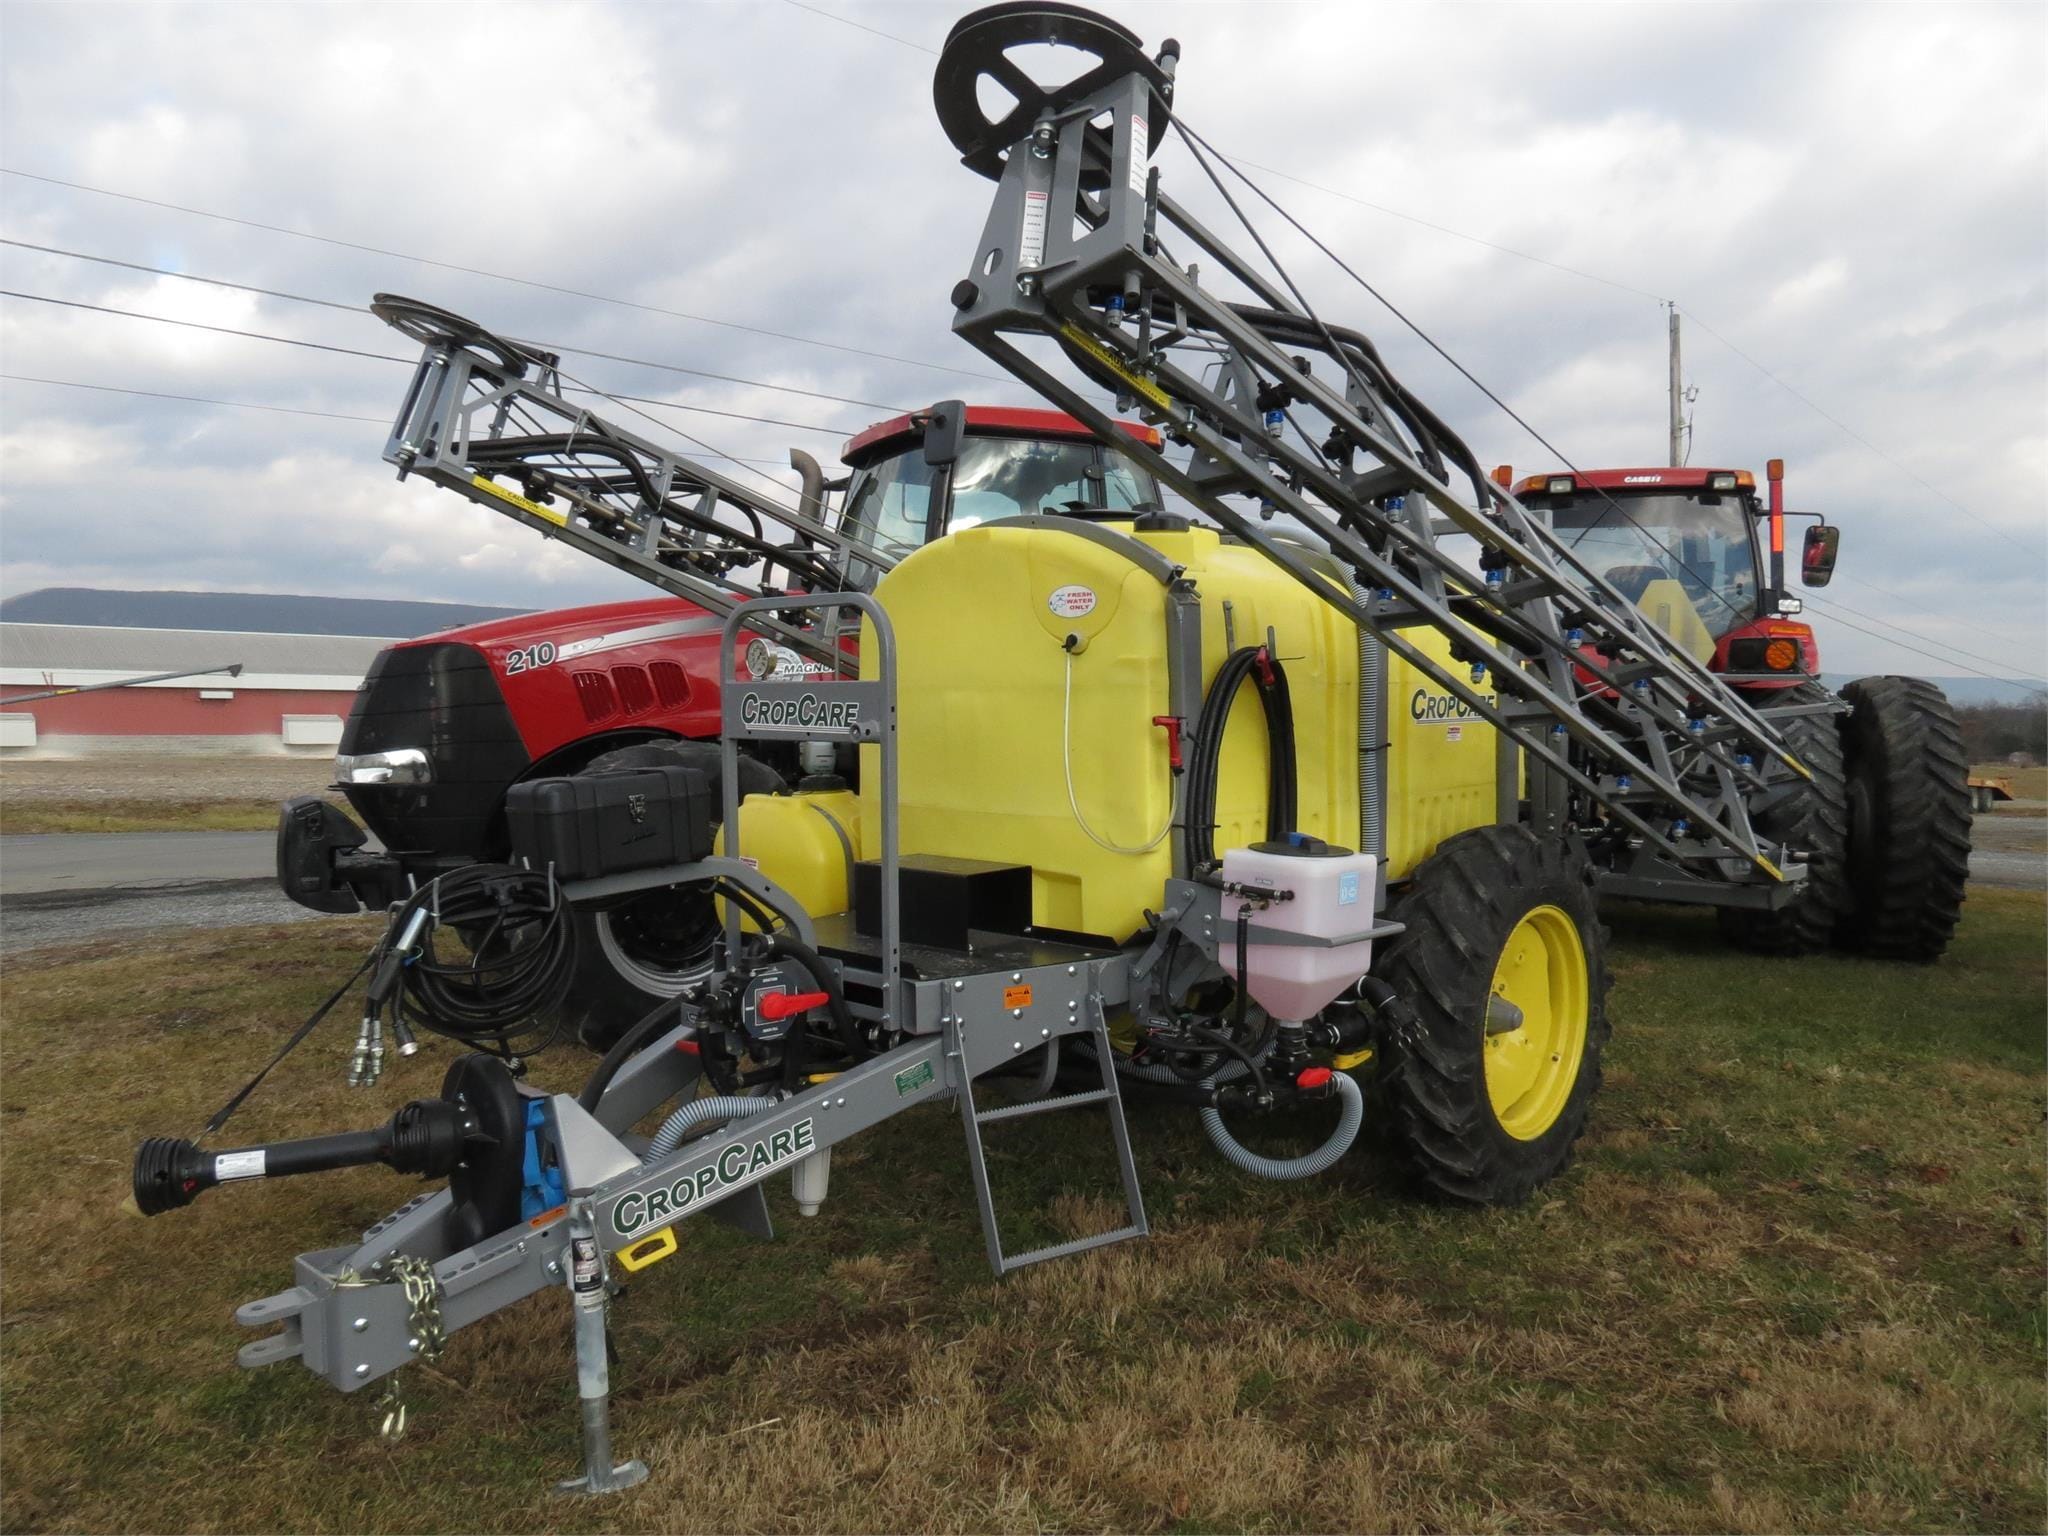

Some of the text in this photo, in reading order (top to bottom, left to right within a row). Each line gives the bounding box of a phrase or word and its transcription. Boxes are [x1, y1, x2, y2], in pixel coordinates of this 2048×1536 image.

[506, 641, 556, 676] 210
[783, 662, 835, 675] MAGNU
[612, 1117, 814, 1236] CROPCARE
